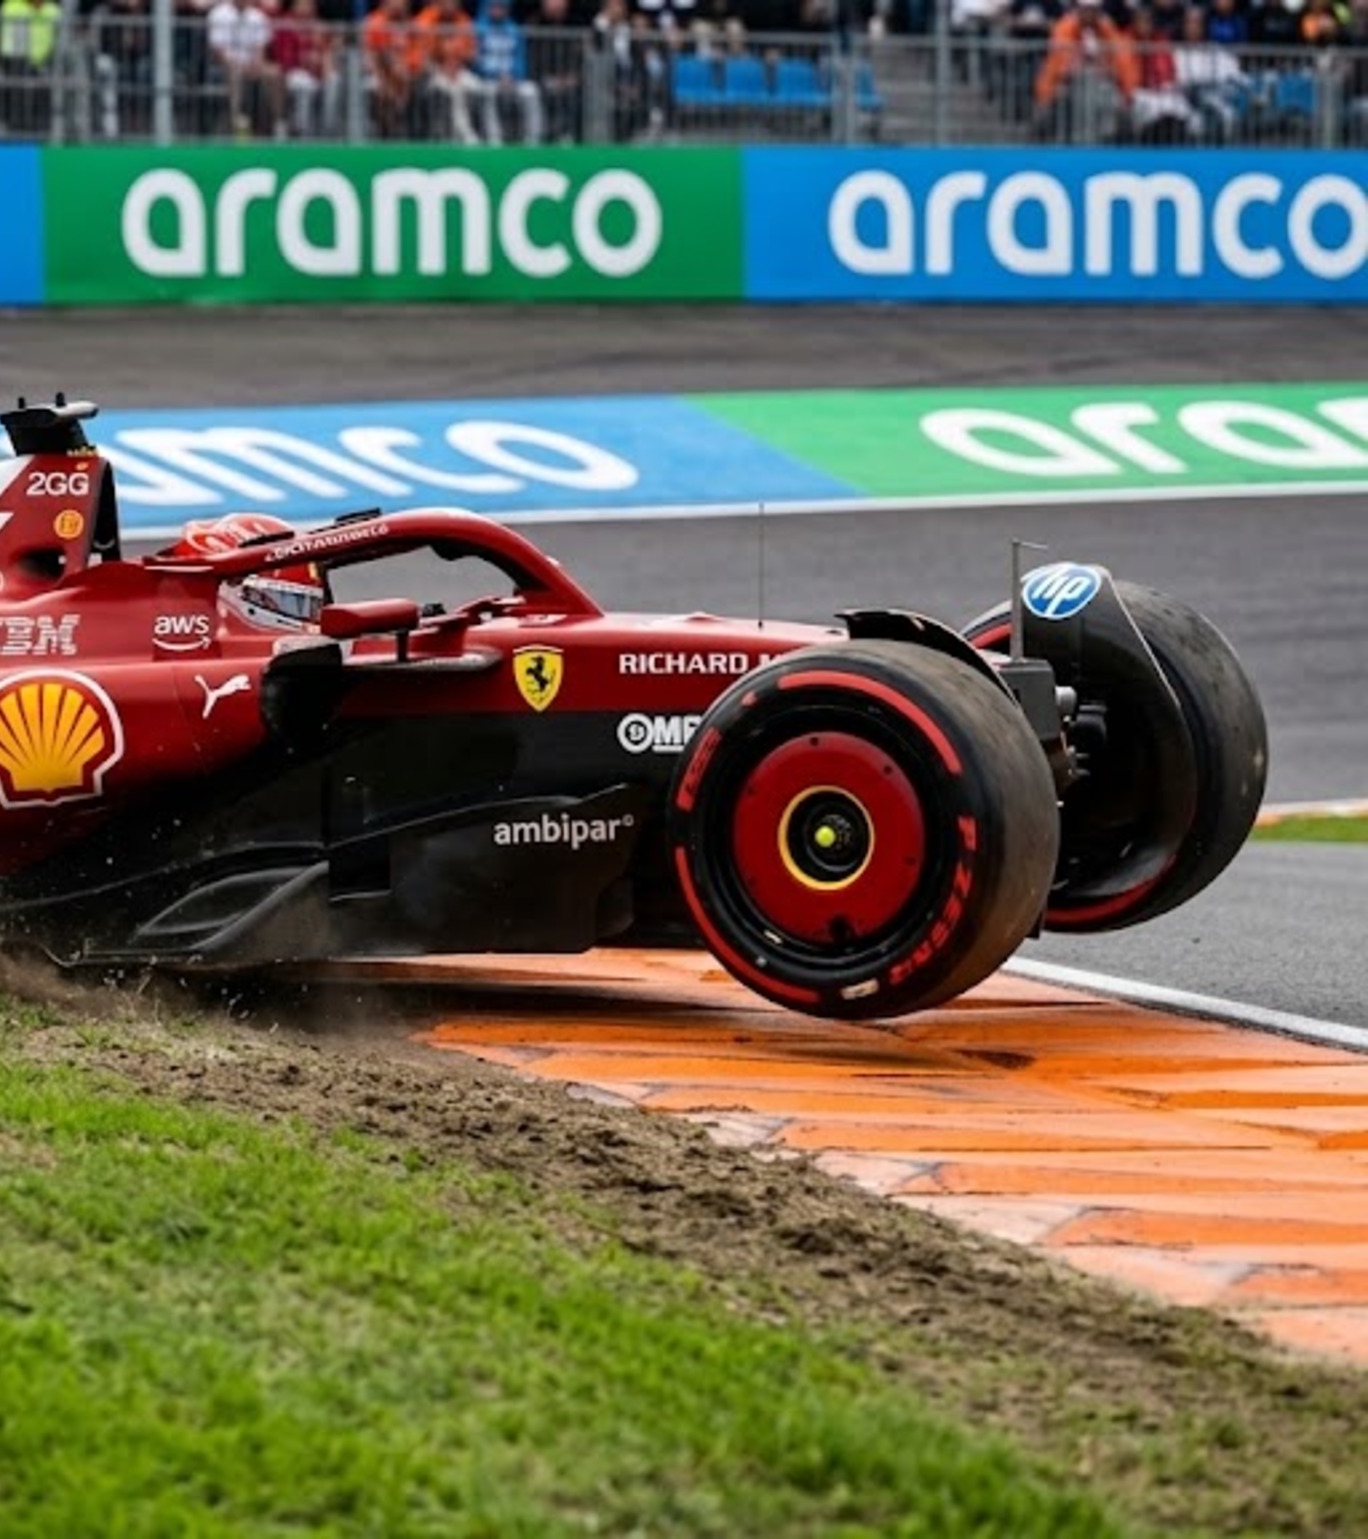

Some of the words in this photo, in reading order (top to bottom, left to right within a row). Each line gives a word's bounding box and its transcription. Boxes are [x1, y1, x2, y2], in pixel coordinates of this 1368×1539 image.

[121, 167, 663, 278] aramco
[828, 169, 1368, 280] aramco
[26, 471, 90, 497] 2GG
[1030, 562, 1094, 618] hp
[153, 614, 210, 635] aws
[618, 652, 749, 675] RICHARD
